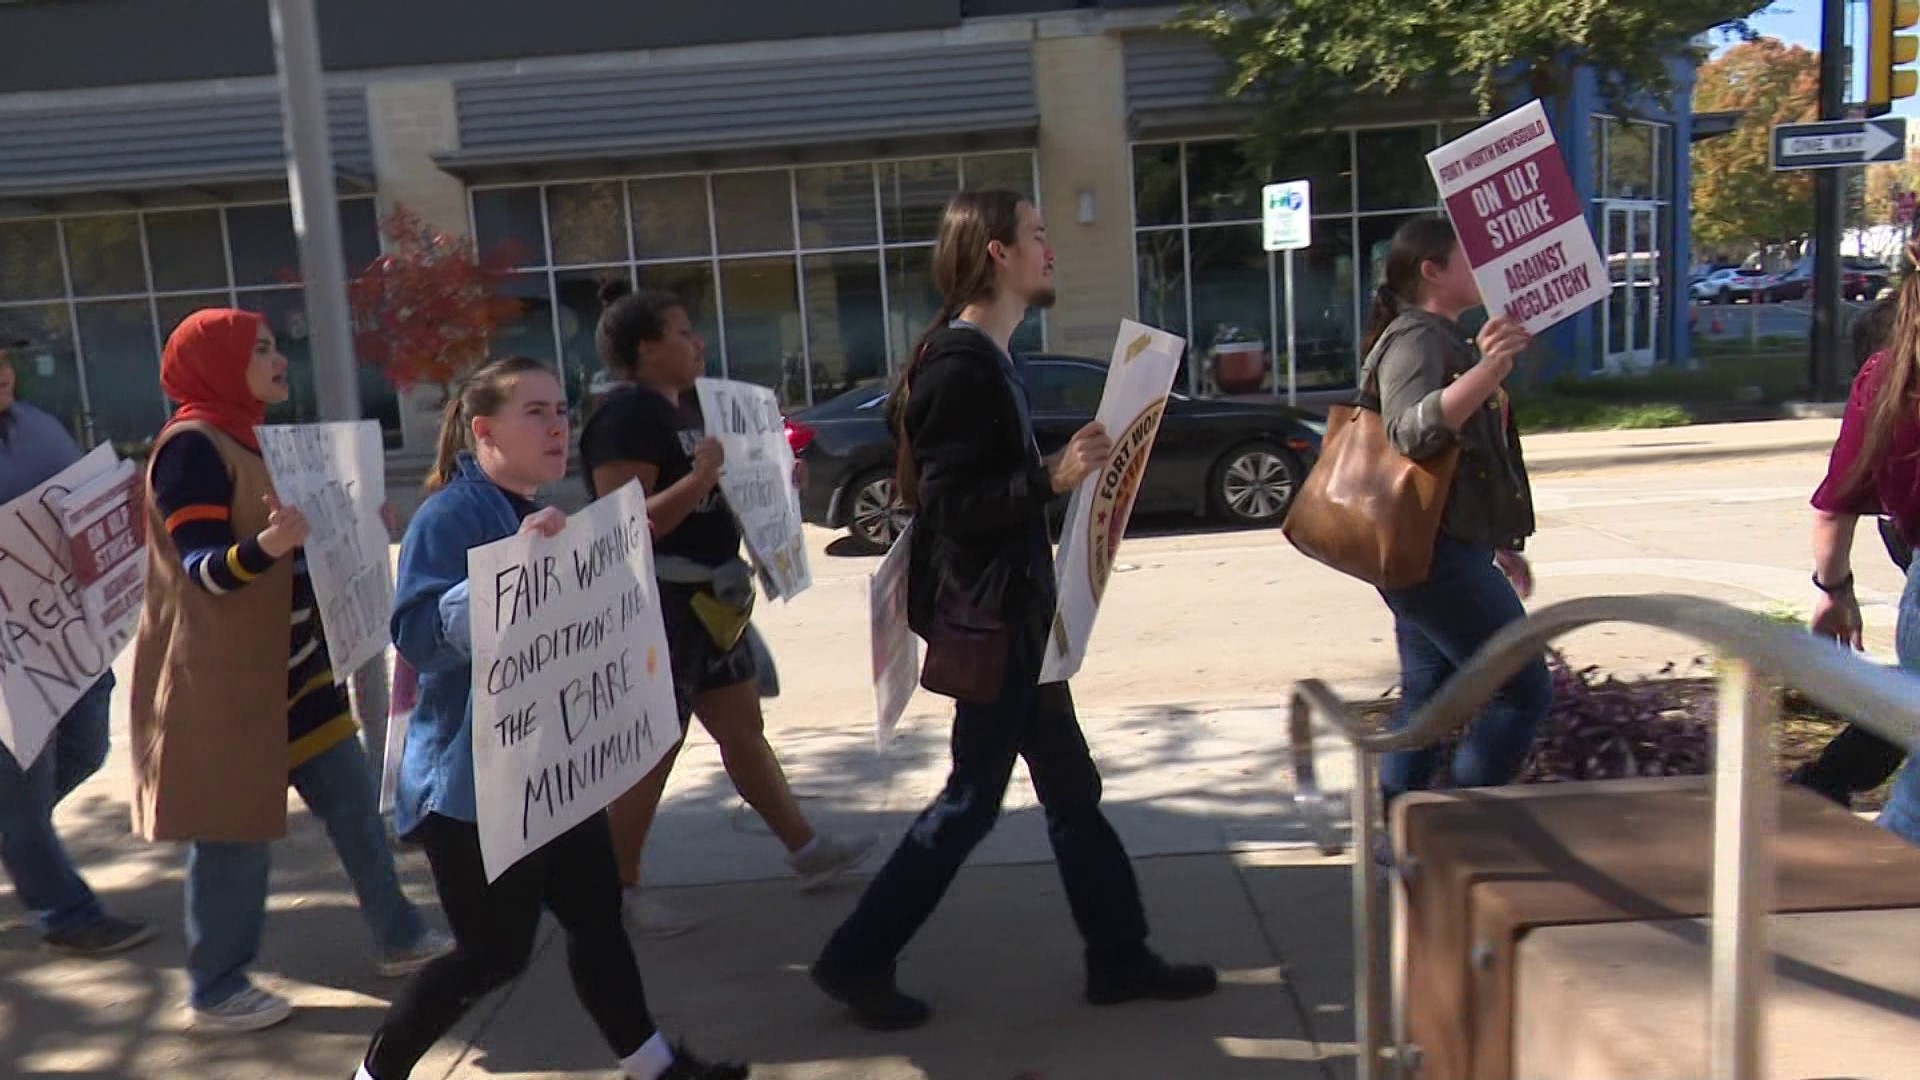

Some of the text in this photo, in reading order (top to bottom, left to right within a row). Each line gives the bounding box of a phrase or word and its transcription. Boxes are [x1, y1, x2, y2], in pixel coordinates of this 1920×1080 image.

[1440, 160, 1466, 185] FORT
[1465, 145, 1495, 172] WORTH
[1792, 138, 1826, 153] ONE
[1472, 161, 1541, 218] ON ULP
[1486, 193, 1555, 250] STRIKE
[1504, 241, 1569, 294] AGAINST
[1504, 263, 1592, 324] MCCLATCHY
[1101, 444, 1131, 502] FORT
[494, 517, 640, 632] FAIR WORKING
[487, 584, 643, 696] CONDITIONS ARE
[494, 647, 633, 748] THE BARE
[523, 711, 656, 840] MINIMUM
